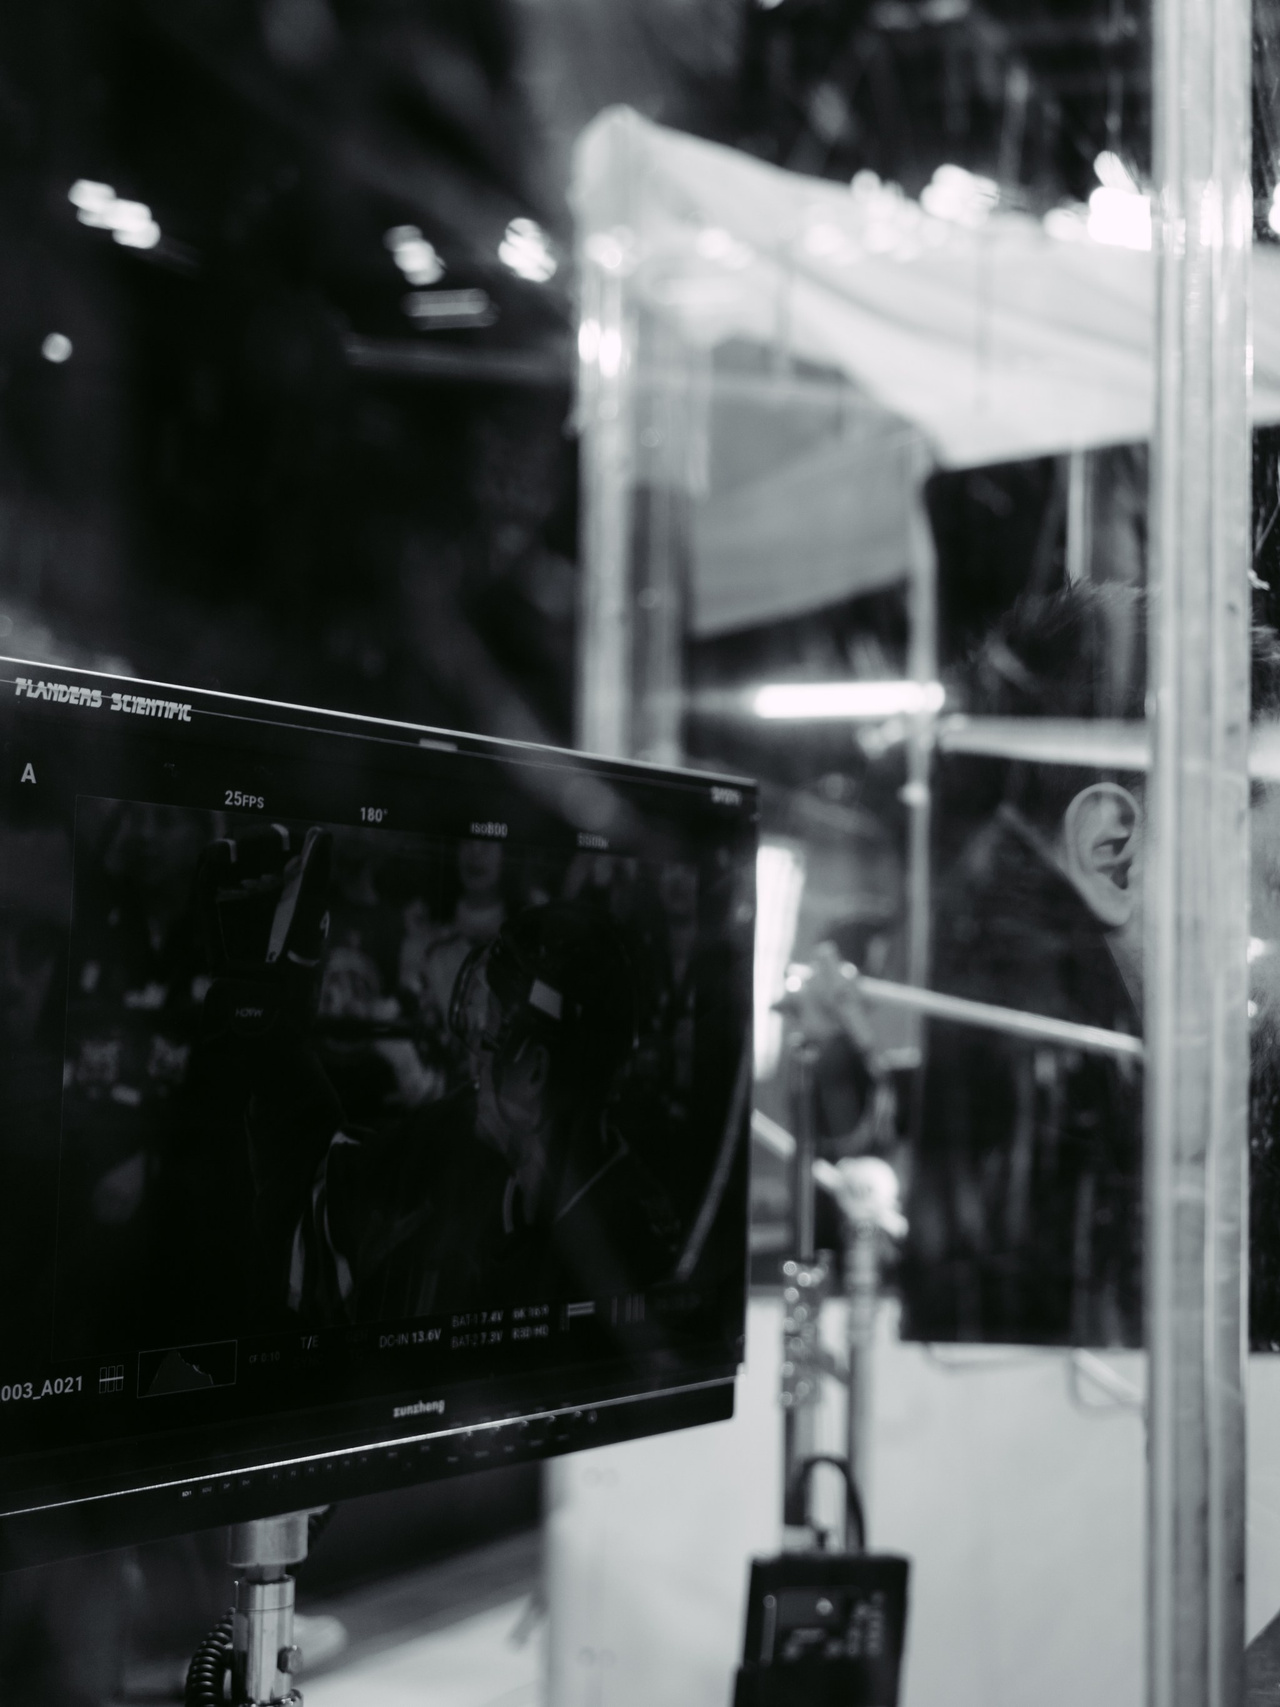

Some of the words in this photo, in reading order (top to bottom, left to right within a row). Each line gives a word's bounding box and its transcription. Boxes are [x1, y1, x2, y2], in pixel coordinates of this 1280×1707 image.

[15, 677, 102, 708] FLANDERS
[110, 692, 192, 722] SCIENTIFIC
[20, 762, 37, 784] A
[224, 790, 265, 810] 25FPS
